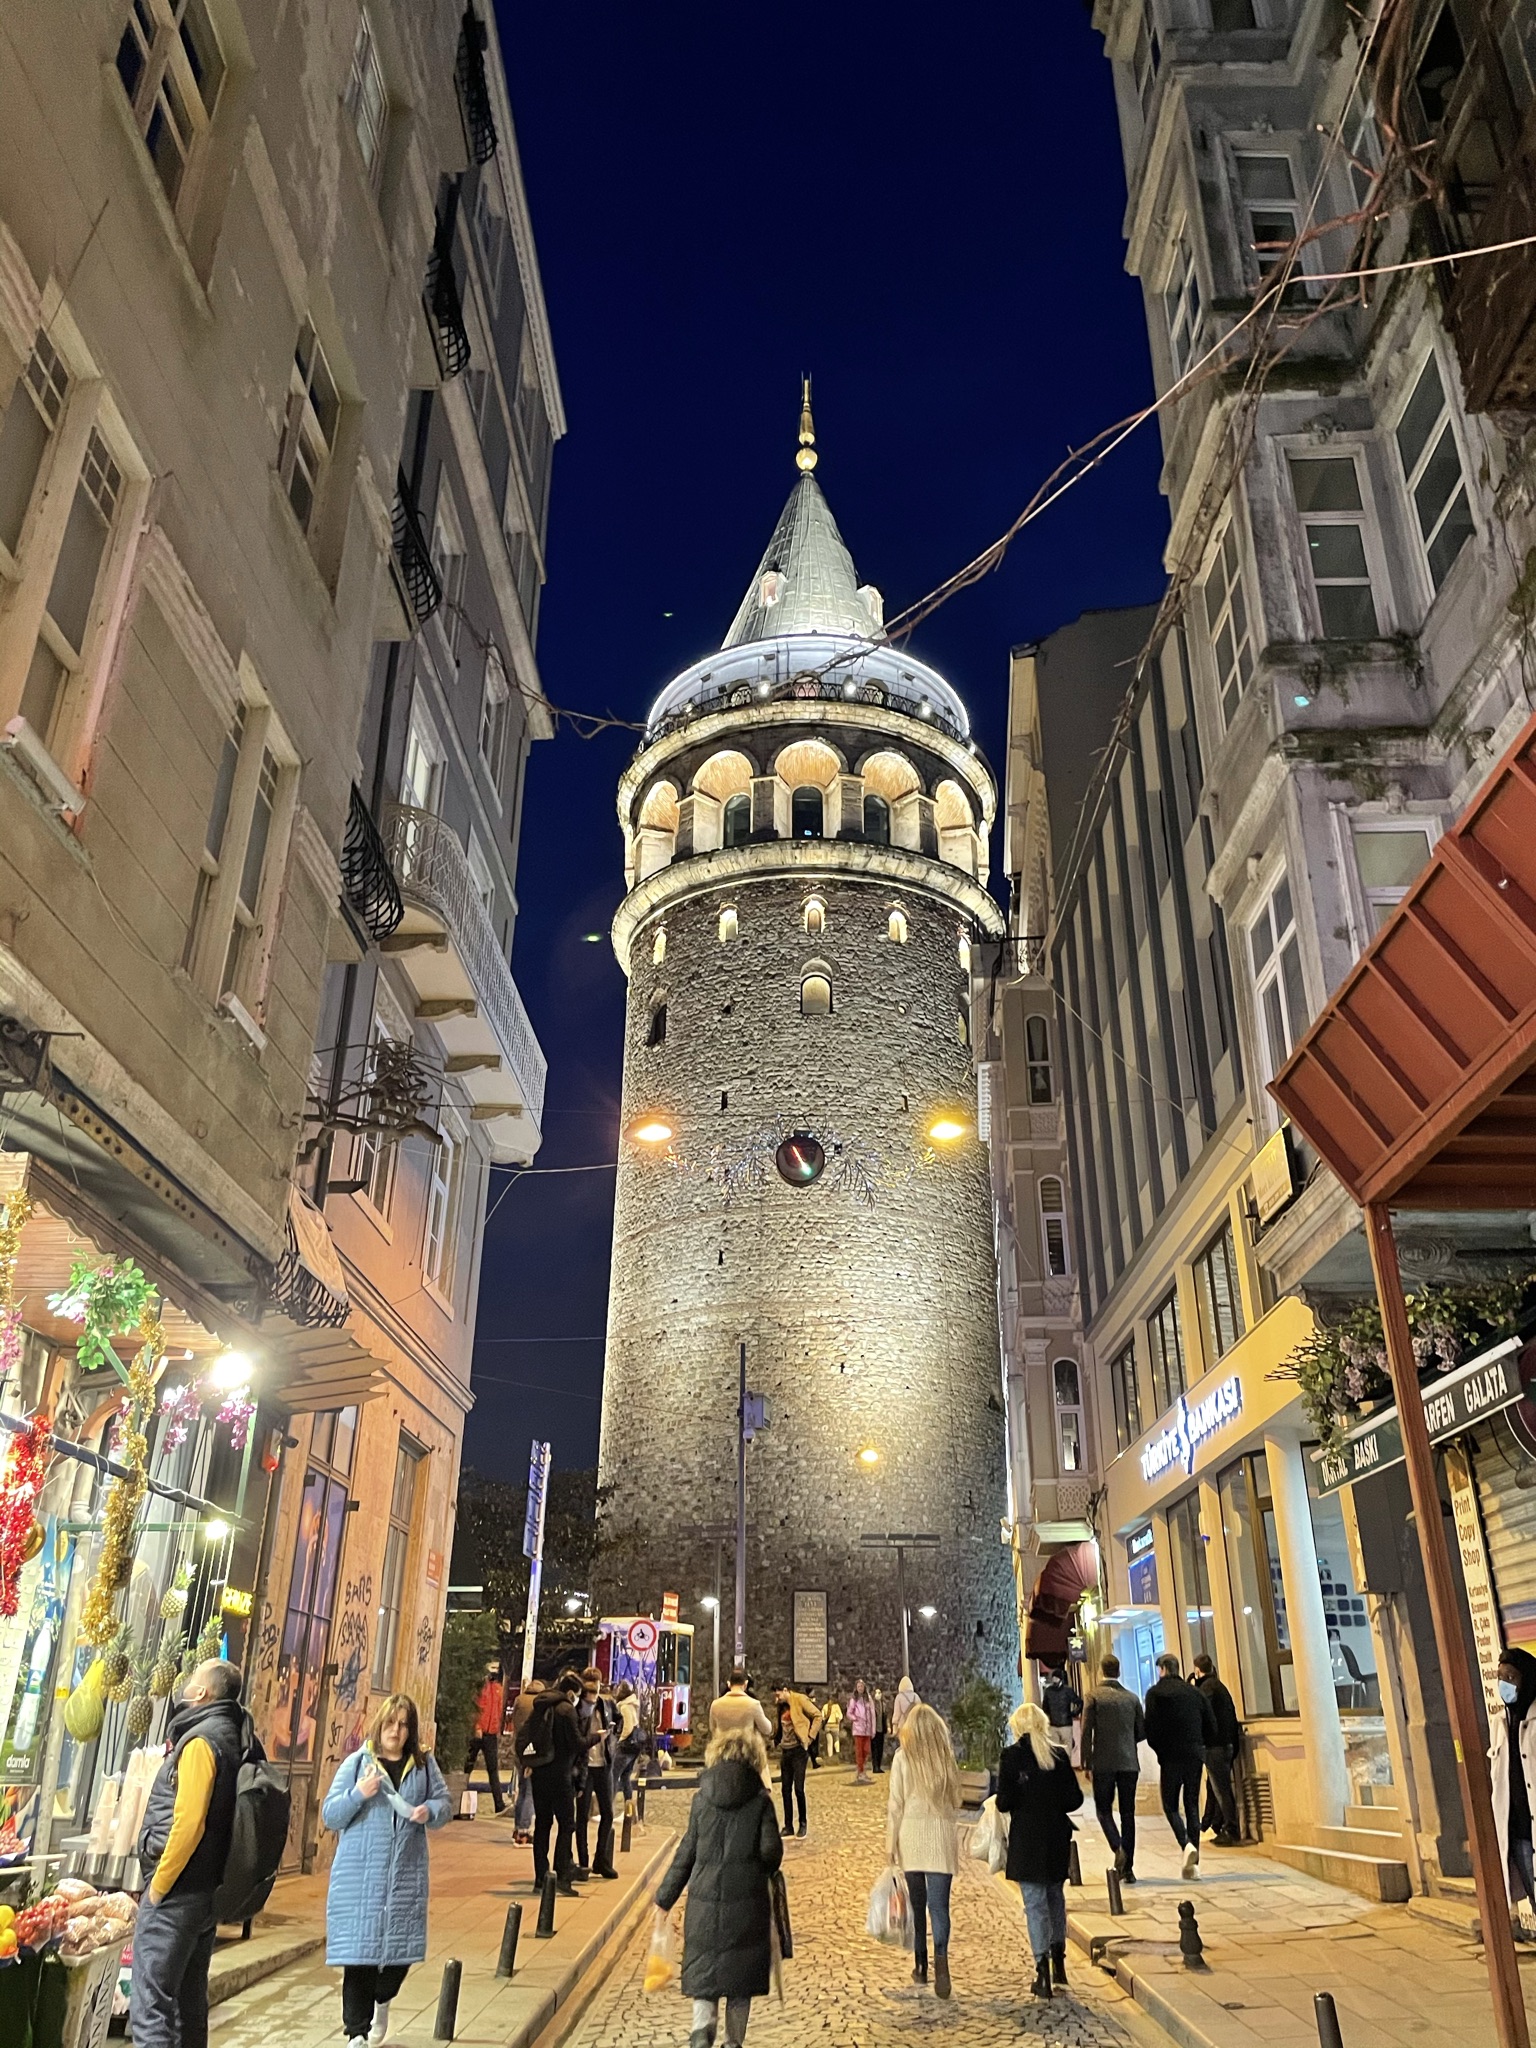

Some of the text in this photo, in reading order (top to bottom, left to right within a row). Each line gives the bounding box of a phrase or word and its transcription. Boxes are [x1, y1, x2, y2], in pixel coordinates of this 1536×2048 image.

[1353, 1434, 1379, 1470] BASKI
[1463, 1364, 1508, 1414] GALATA
[1454, 1495, 1471, 1517] Print
[1458, 1523, 1476, 1543] Copy
[1462, 1548, 1481, 1567] Shop
[6, 1754, 30, 1768] damla
